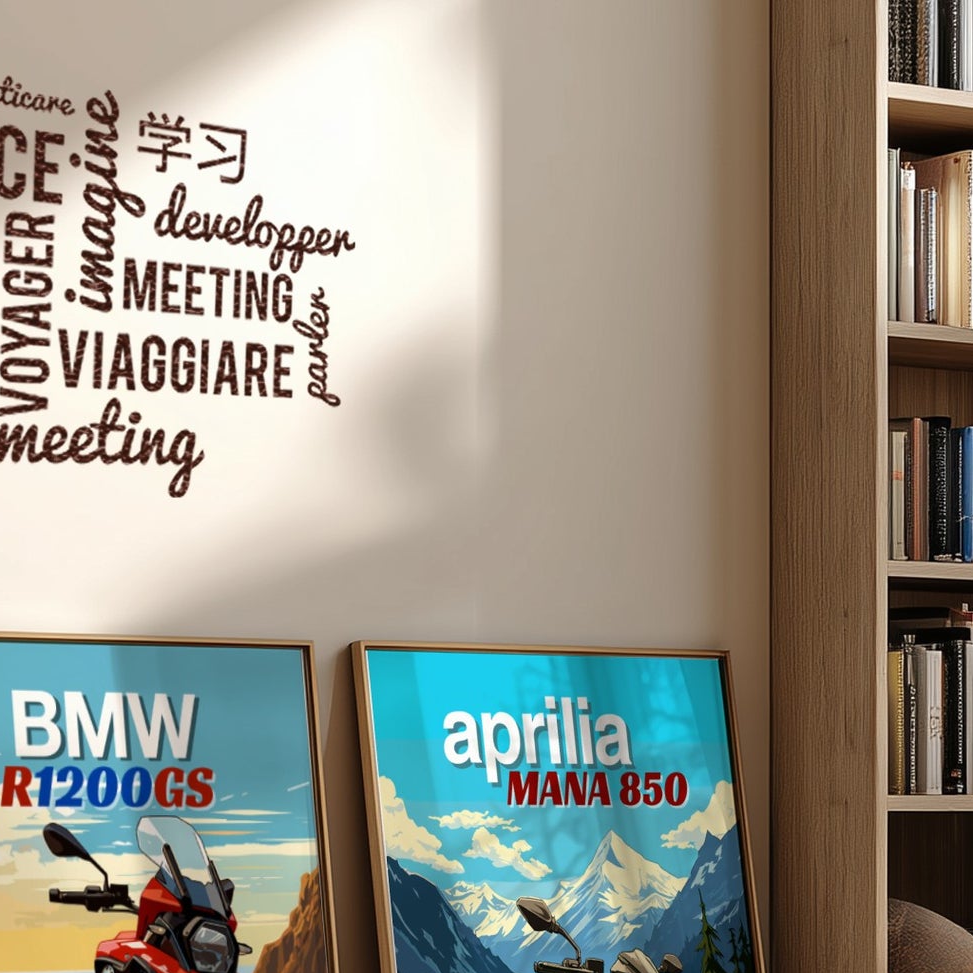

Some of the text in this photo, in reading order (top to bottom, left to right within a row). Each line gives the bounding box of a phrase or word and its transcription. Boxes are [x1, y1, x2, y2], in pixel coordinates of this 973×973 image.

[137, 111, 248, 184] 学习
[65, 89, 146, 312] imagine
[154, 182, 356, 272] developper
[123, 257, 294, 323] MEETING
[58, 328, 295, 398] VIAGGIARE
[292, 286, 341, 407] parler
[11, 690, 199, 761] BMW
[443, 696, 635, 787] aprilia
[0, 765, 216, 811] R1200GS
[507, 771, 689, 808] MANA 850
